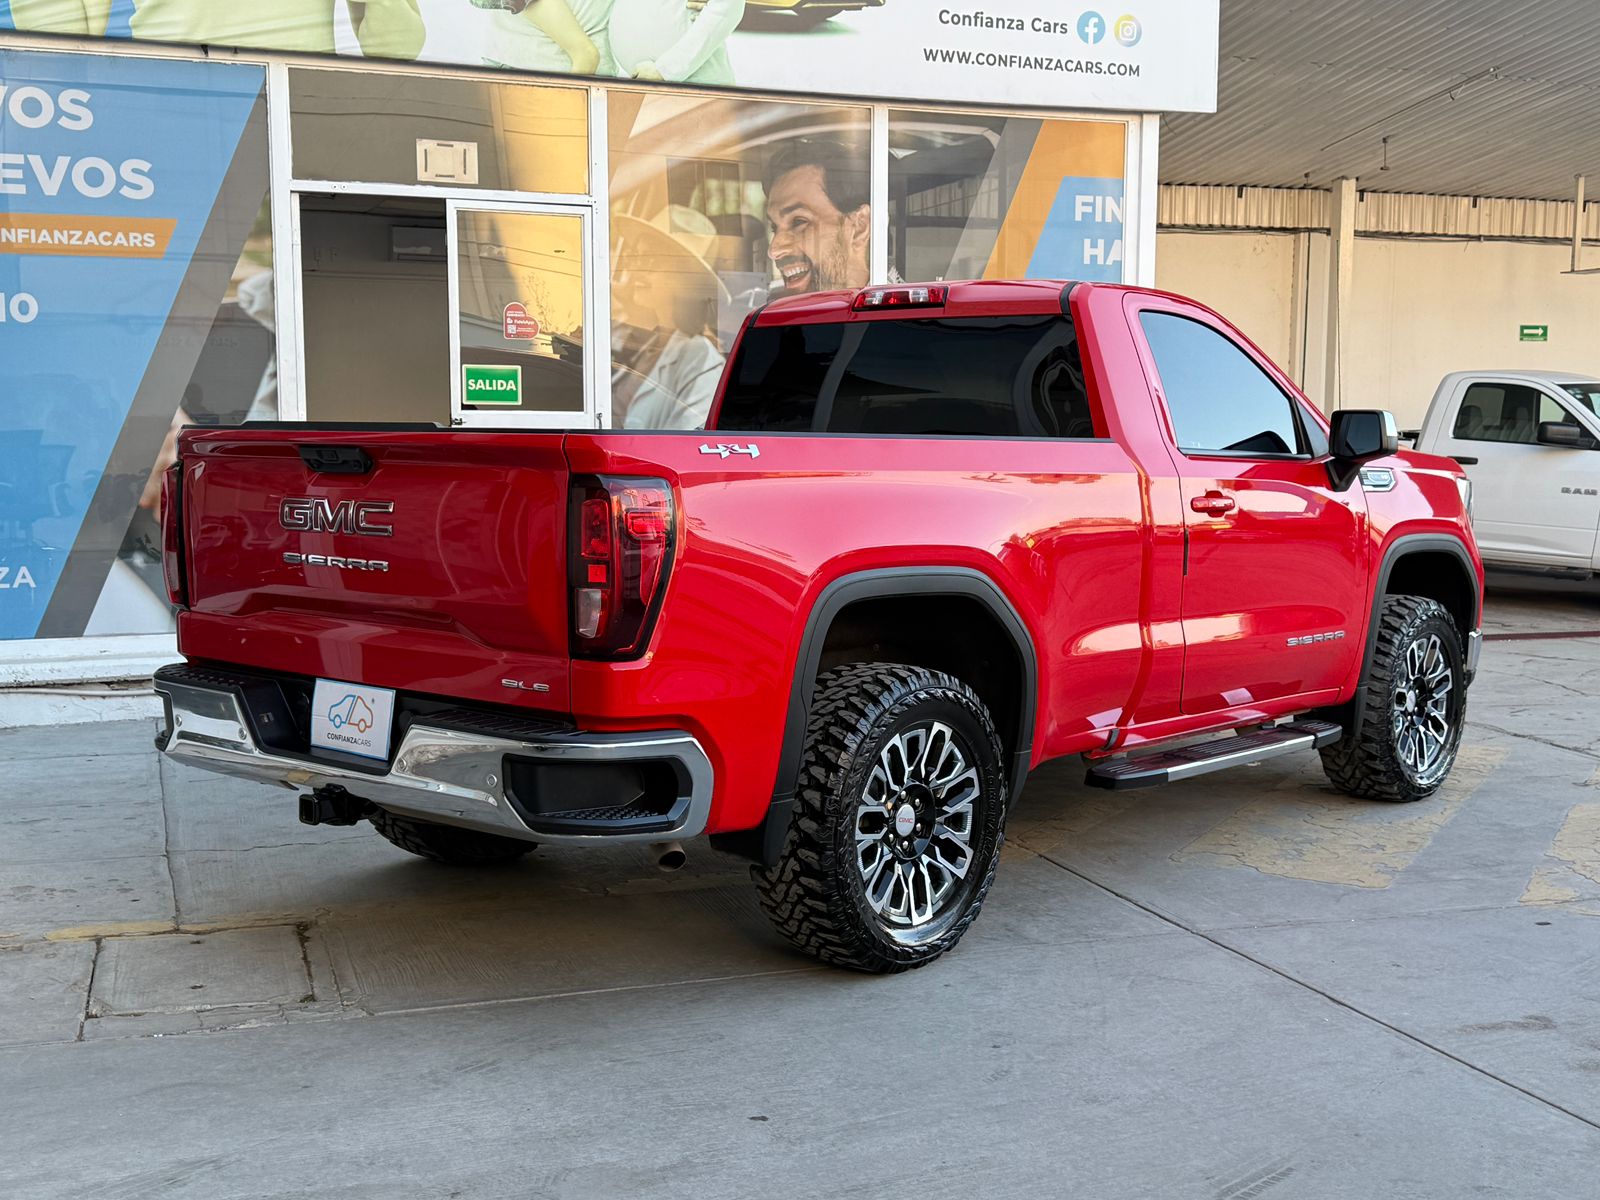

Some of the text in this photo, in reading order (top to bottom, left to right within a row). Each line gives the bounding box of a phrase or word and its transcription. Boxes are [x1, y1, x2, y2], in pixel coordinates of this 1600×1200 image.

[938, 9, 1025, 31] Confianza
[1030, 17, 1068, 34] Cars
[923, 48, 1140, 77] WWW.CONFIANZACARS.COM
[0, 85, 94, 131] OS
[0, 153, 155, 200] EVOS
[1074, 195, 1123, 224] FIN
[0, 227, 156, 248] NFIANZACARS
[467, 379, 517, 391] SALIDA
[1560, 486, 1598, 496] RAM
[279, 498, 394, 536] GMC
[283, 551, 390, 572] SIERRA
[1286, 630, 1345, 647] SIERRA
[501, 678, 550, 692] SLE
[326, 732, 372, 747] CONFIANZACARS
